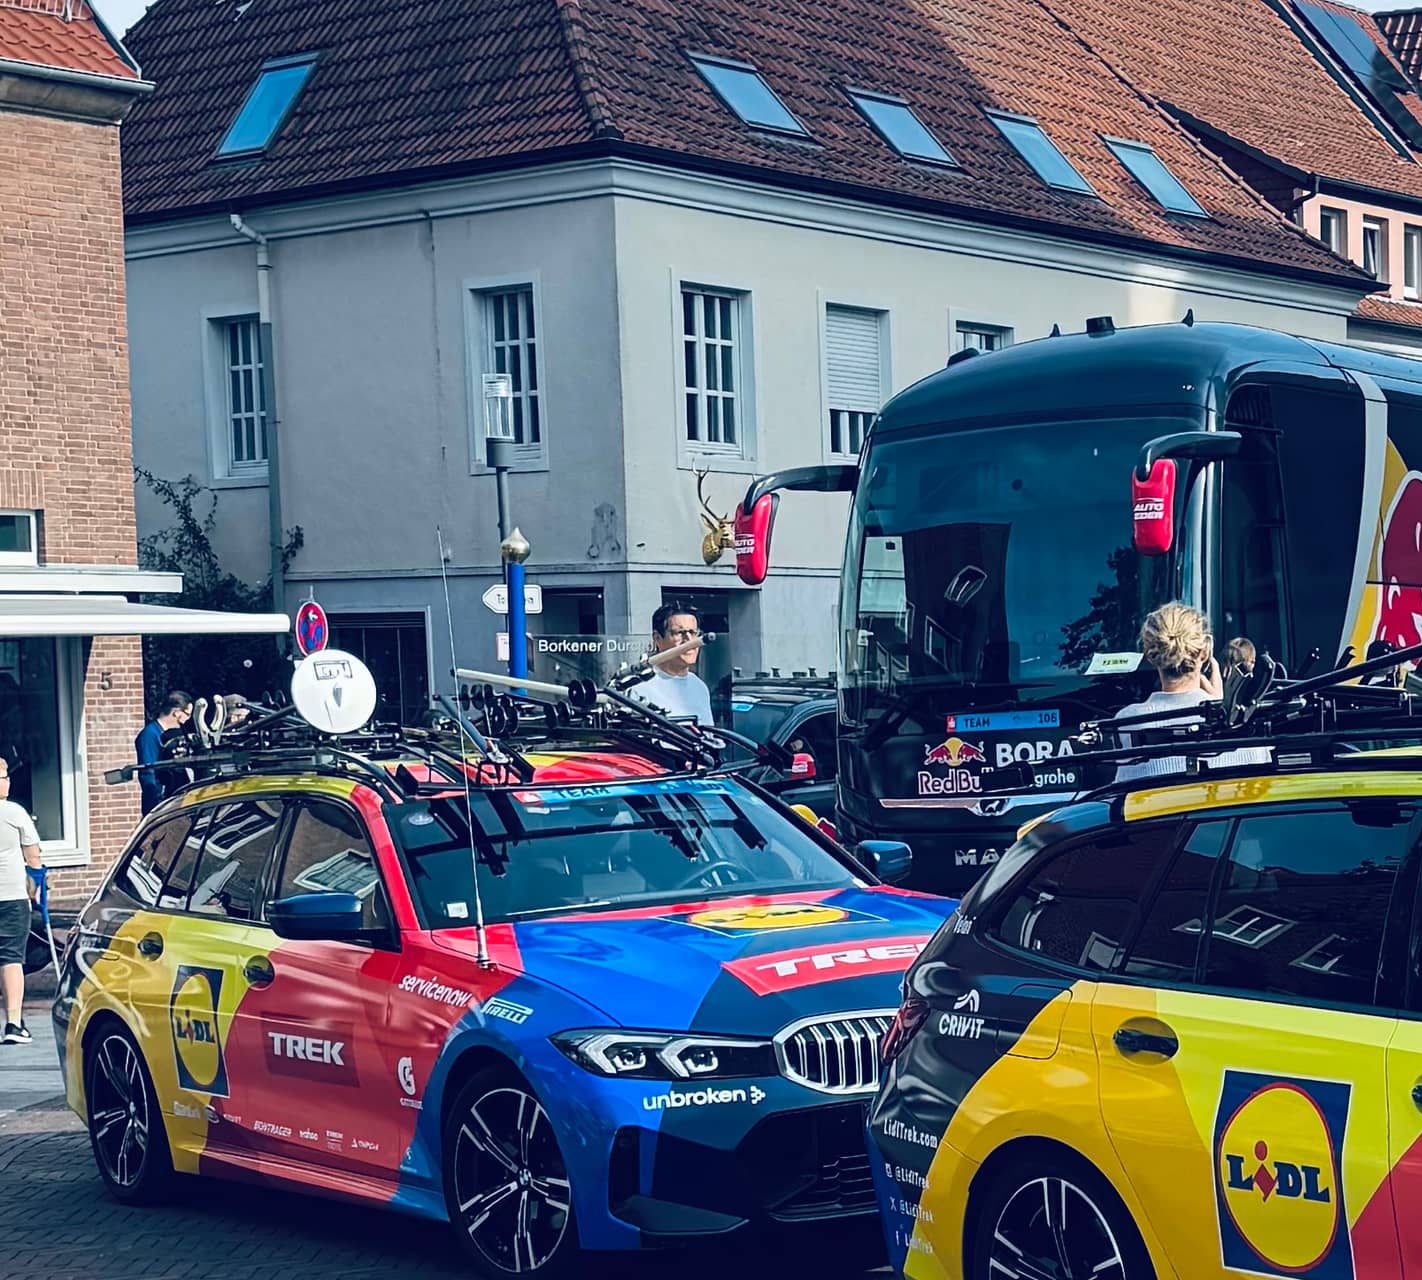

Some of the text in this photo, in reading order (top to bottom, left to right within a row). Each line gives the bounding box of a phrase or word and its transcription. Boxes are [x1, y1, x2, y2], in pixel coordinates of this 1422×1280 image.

[1134, 503, 1164, 512] AUTO
[538, 639, 602, 653] Borkener
[101, 672, 113, 691] 5
[963, 712, 1057, 729] TEAM 106
[996, 740, 1074, 767] BORA
[1034, 768, 1075, 788] grohe
[955, 849, 1008, 866] MA
[398, 975, 473, 1008] servicenow
[481, 997, 534, 1025] PIRELLI
[174, 1009, 216, 1046] LIDL
[939, 1013, 985, 1039] CRIVIT
[268, 1031, 345, 1066] TREK
[643, 1087, 747, 1110] unbroken
[883, 1117, 938, 1149] LidlTrek.com
[1226, 1140, 1331, 1204] LIDL
